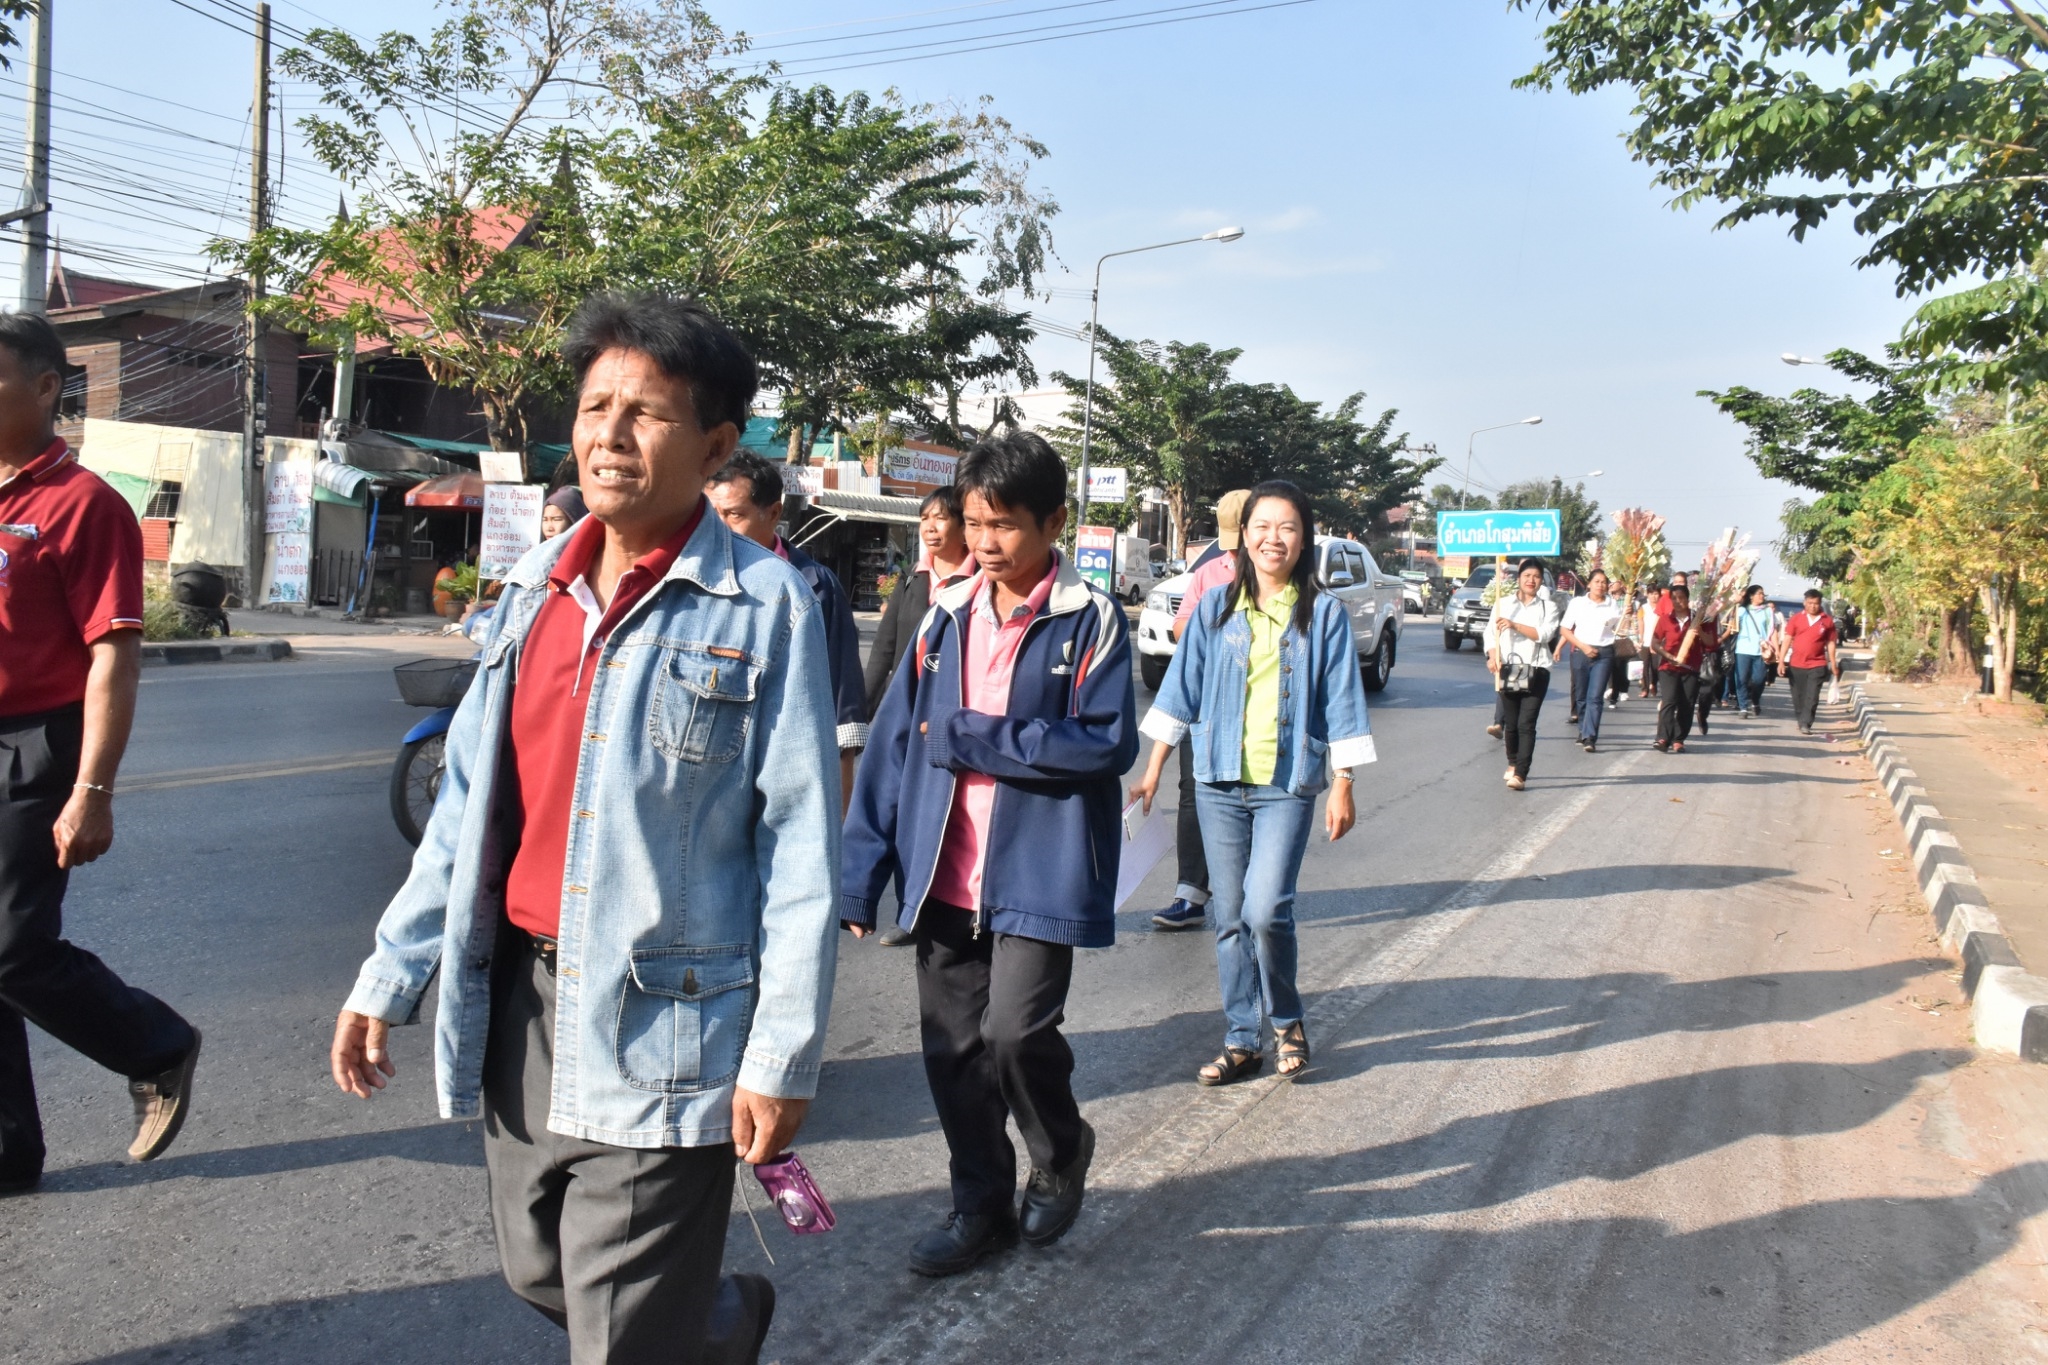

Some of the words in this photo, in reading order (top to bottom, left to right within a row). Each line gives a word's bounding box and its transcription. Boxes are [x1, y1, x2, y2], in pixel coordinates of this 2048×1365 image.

[1097, 475, 1117, 486] ptt
[486, 530, 521, 542] แกงอ่อม
[1080, 528, 1112, 548] ล้าง
[1444, 519, 1552, 552] อำเภอโกสุมพิสัย
[1080, 550, 1108, 570] อัด
